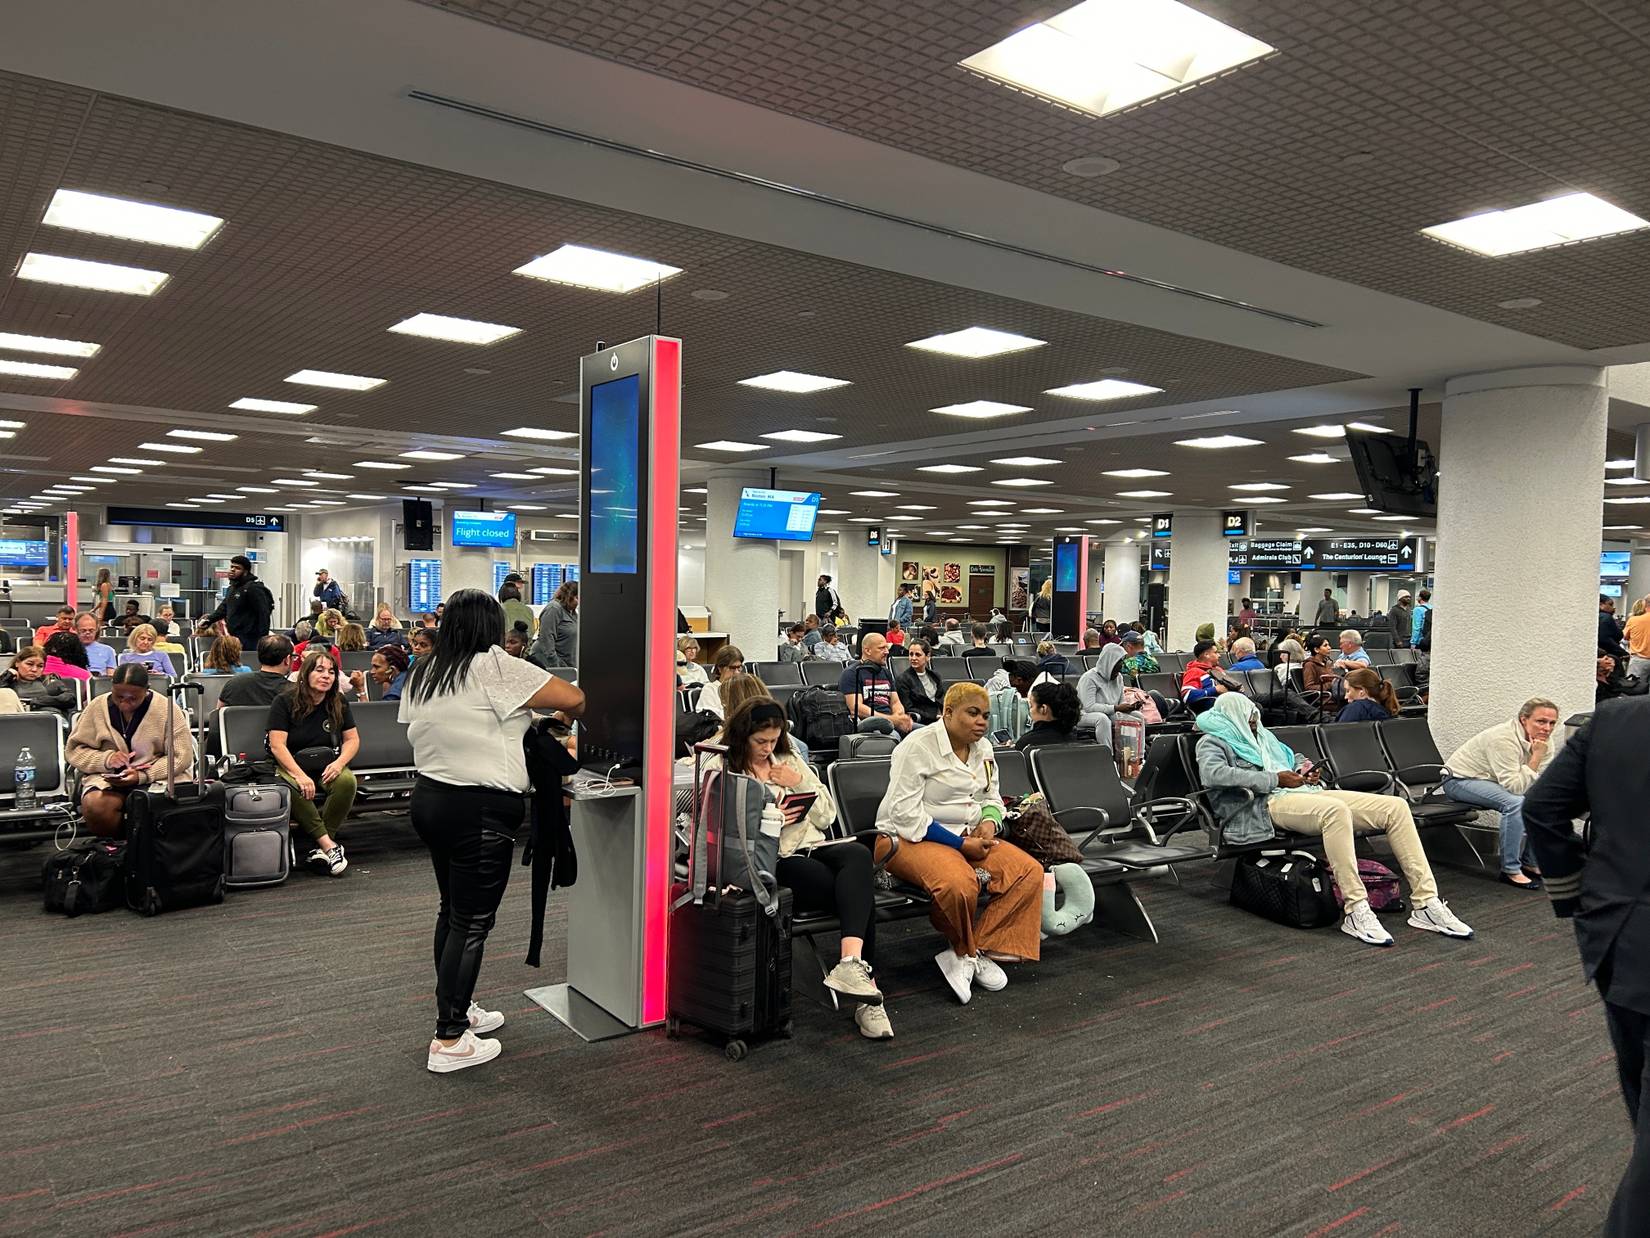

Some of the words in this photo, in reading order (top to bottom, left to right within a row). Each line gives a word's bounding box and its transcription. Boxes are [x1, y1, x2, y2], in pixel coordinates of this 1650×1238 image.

[1157, 518, 1169, 529] D1
[1227, 516, 1241, 527] D2
[456, 527, 480, 539] Flight
[482, 529, 510, 538] closed
